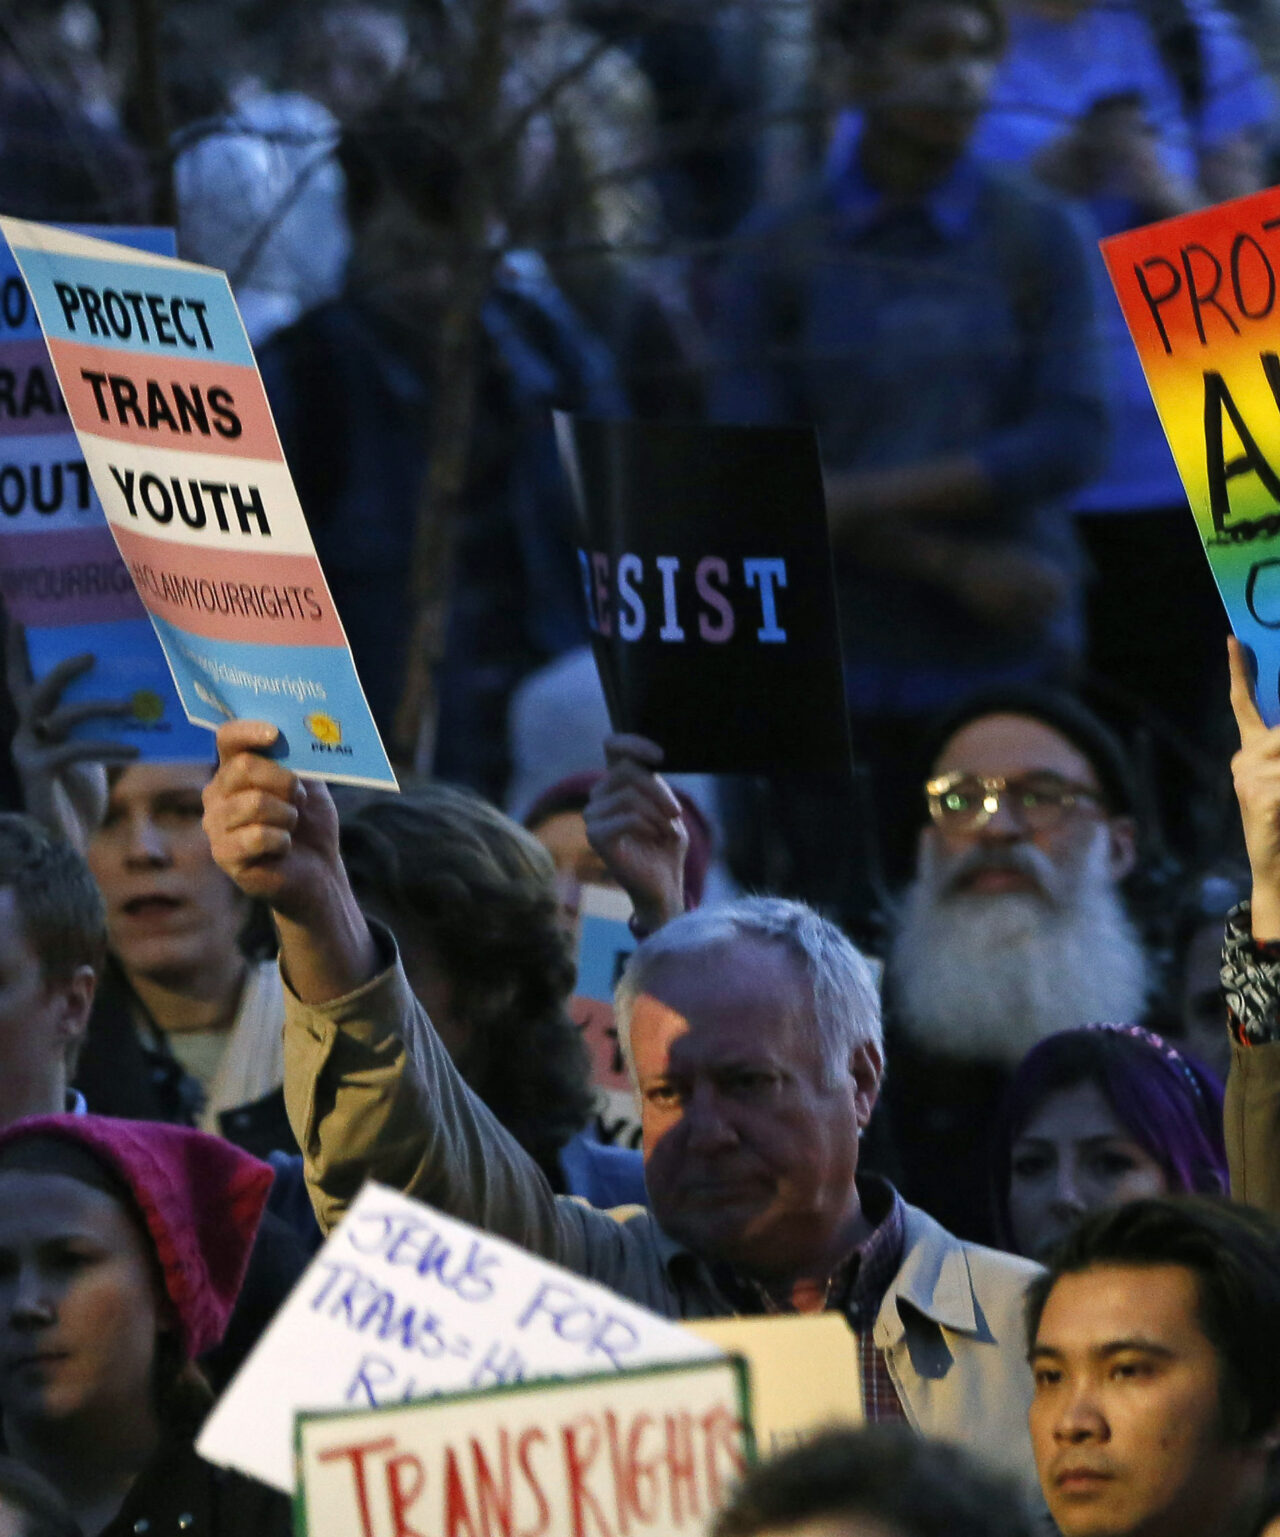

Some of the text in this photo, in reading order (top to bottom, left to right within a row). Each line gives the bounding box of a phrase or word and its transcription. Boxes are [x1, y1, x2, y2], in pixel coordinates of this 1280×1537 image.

[53, 280, 214, 350] PROTECT
[81, 367, 243, 440] TRANS
[0, 461, 91, 517] OUT
[108, 463, 272, 537] YOUTH
[133, 560, 322, 621] #CLAIMYOURRIGHTS
[348, 1211, 501, 1302] JEWS
[517, 1278, 640, 1370] FOR
[318, 1426, 549, 1537] TRANS
